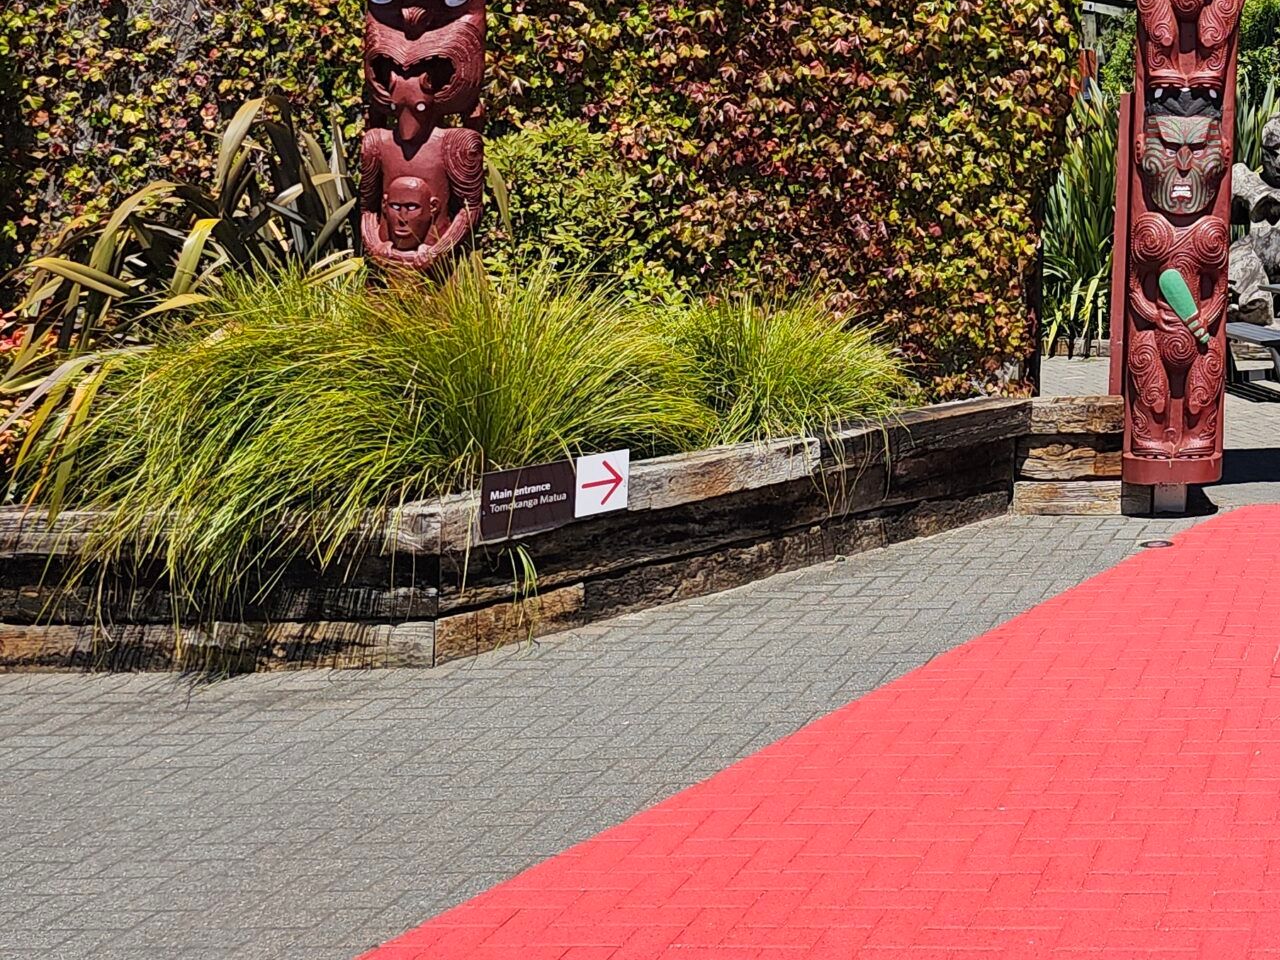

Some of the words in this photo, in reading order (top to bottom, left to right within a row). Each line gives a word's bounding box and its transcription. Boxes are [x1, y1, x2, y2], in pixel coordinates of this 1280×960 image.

[490, 489, 512, 500] Main
[514, 483, 551, 496] entrance
[490, 498, 538, 513] Tomokanga
[540, 493, 567, 505] Matua
